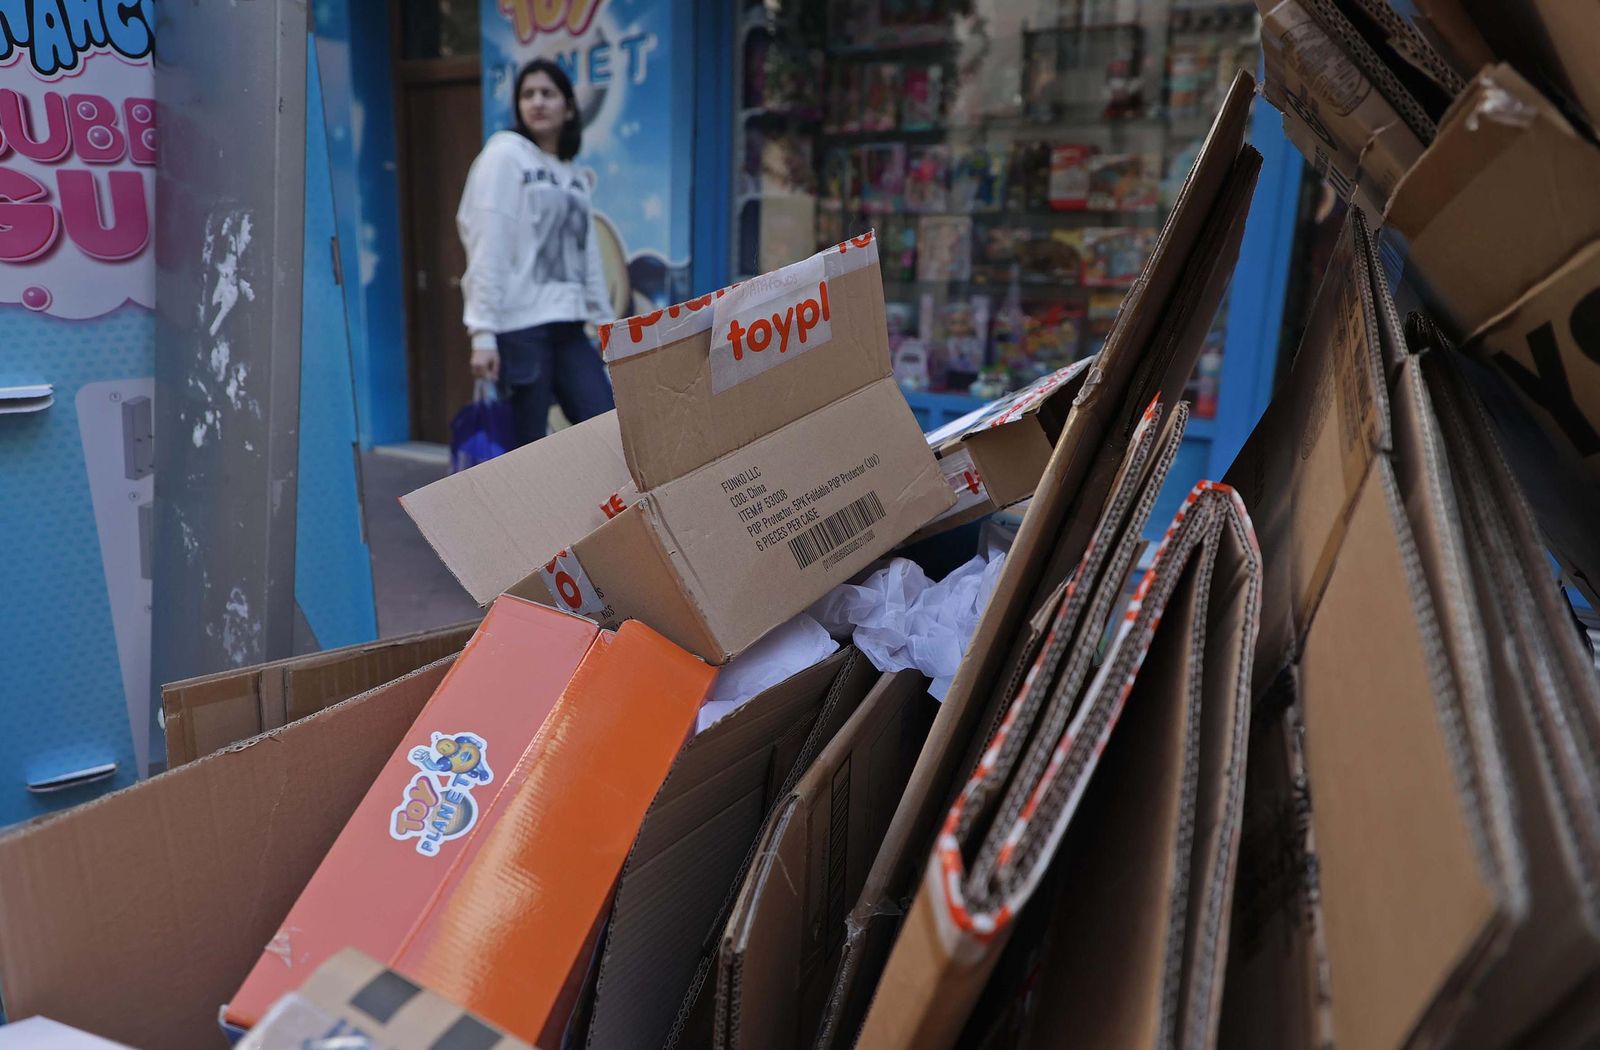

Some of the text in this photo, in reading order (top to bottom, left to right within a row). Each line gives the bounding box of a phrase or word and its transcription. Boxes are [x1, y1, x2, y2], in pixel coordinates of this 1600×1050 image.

[727, 280, 831, 361] toypl
[721, 466, 762, 494] FUNKO LLC
[738, 489, 788, 522] ITEM# 53008
[747, 453, 880, 538] POP Protector: 5PK Foldable POP Protector (UV)
[750, 483, 768, 499] China
[755, 507, 820, 552] 6 PIECES PER CASE
[396, 775, 439, 836] TOY
[421, 773, 470, 853] PLANET
